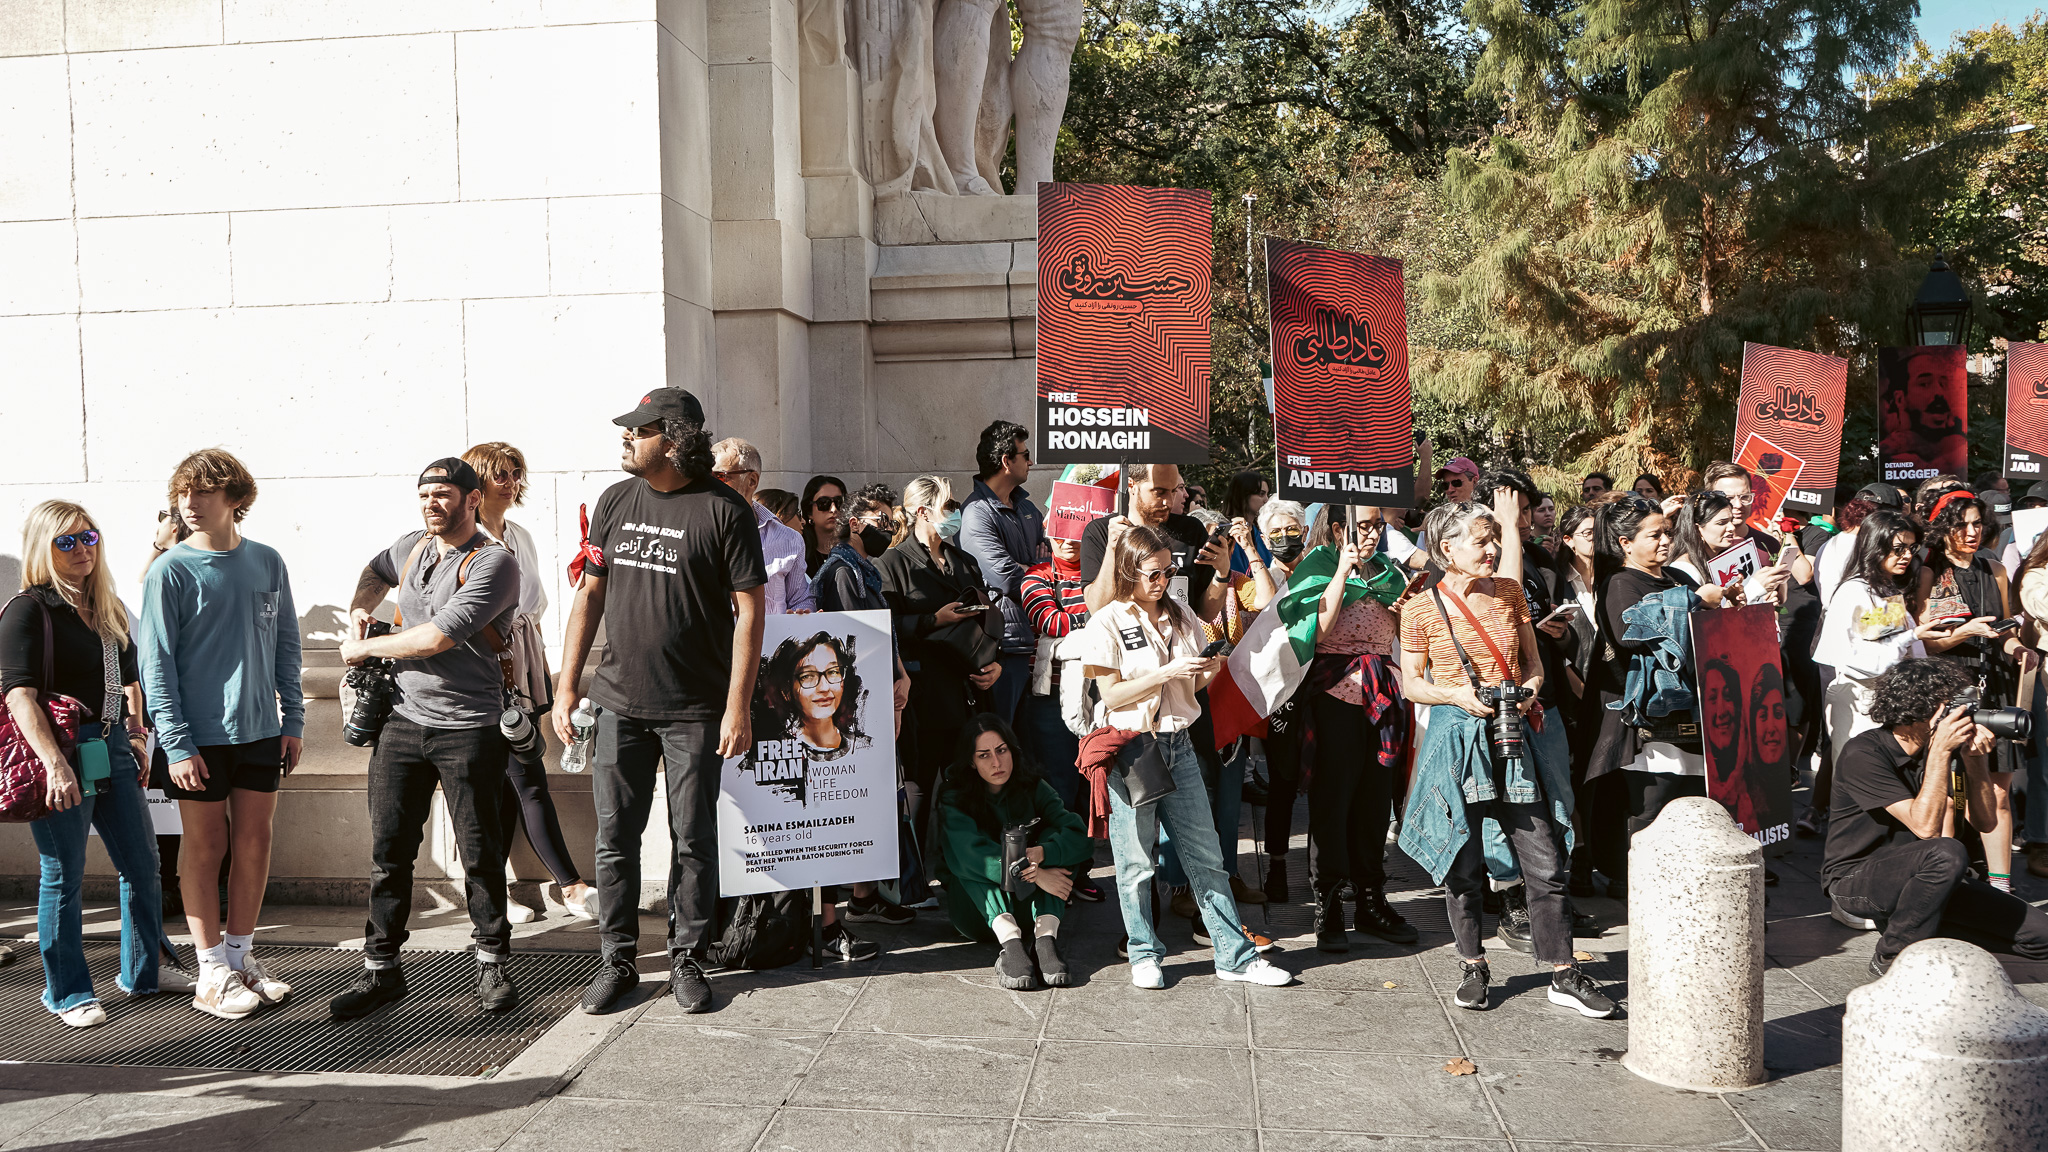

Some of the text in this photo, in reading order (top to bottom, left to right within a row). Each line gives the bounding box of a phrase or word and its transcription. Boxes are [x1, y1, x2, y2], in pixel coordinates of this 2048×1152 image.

[1048, 392, 1079, 403] FREE
[1048, 407, 1149, 426] HOSSEIN
[1048, 431, 1151, 450] RONAGHI
[1287, 454, 1312, 466] FREE
[2010, 453, 2030, 461] FREE
[1885, 469, 1940, 481] BLOGGER
[2010, 461, 2040, 473] JADI
[1288, 469, 1398, 495] ADEL TALEBI
[1785, 489, 1822, 506] ALEBI
[1056, 510, 1086, 522] Mahsa
[614, 535, 678, 562] زن زندگی آزادی
[757, 738, 803, 761] FREE
[754, 758, 804, 782] IRAN
[812, 764, 856, 777] WOMAN
[812, 778, 837, 790] LIFE
[813, 788, 869, 802] FREEDOM
[743, 815, 856, 835] SARINA ESMAILZADEH
[744, 829, 813, 847] 16 years old
[745, 840, 874, 859] WAS KILLED WHEN THE SECURITY FORCES
[745, 858, 763, 866] BEAT
[763, 857, 776, 865] HER
[777, 855, 795, 863] WITH
[801, 852, 825, 861] BATON
[825, 850, 851, 858] DURING
[745, 865, 777, 874] PROTEST.
